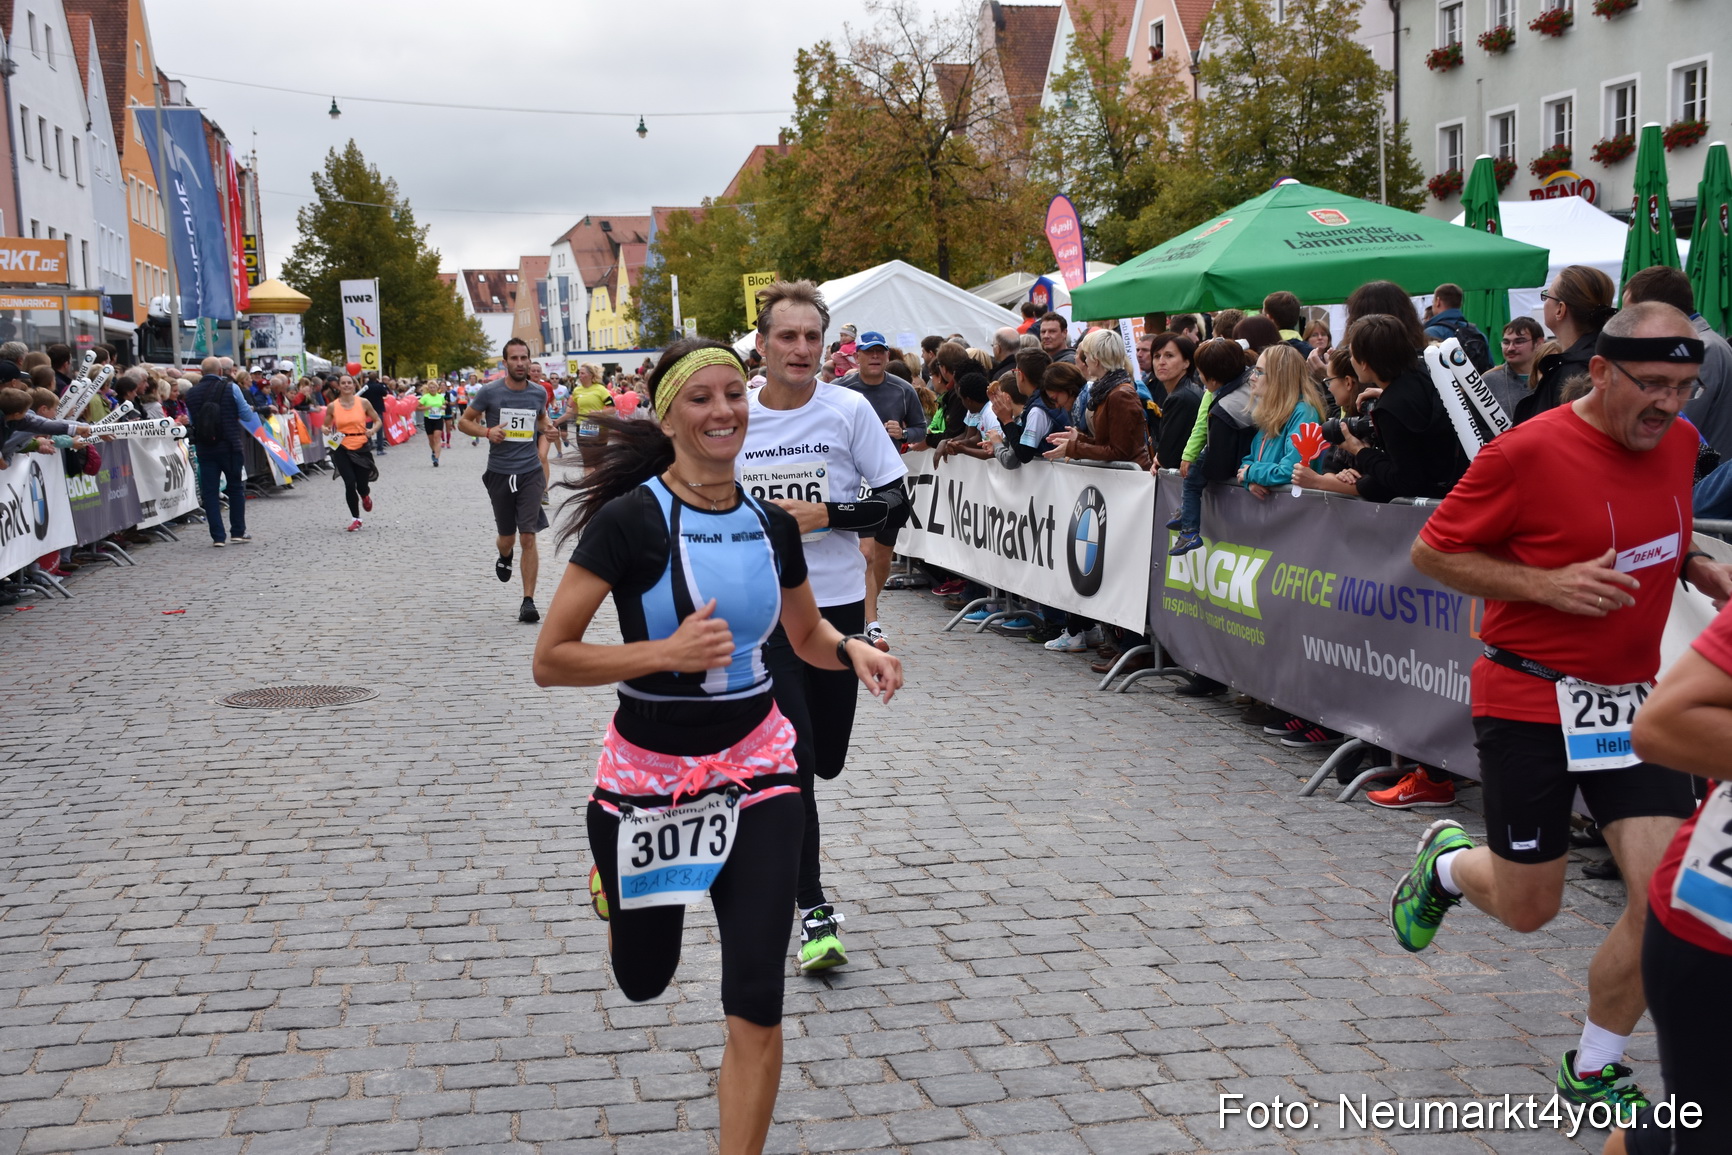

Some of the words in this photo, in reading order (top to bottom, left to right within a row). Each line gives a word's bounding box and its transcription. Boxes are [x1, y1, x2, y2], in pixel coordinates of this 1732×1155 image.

[1283, 232, 1424, 250] Lammsbräu
[1295, 226, 1393, 239] Neumarkter
[748, 275, 776, 286] Block
[364, 351, 374, 365] C
[429, 368, 436, 376] D
[1465, 370, 1496, 408] BMW
[90, 424, 131, 435] Laufsport
[132, 421, 155, 431] BMW
[511, 416, 525, 429] 51
[745, 443, 830, 460] www.hasit.de
[742, 472, 770, 483] PARTL
[771, 470, 813, 481] Neumarkt
[949, 479, 1056, 570] Neumarkt
[1632, 546, 1663, 564] DEHN
[1271, 562, 1337, 608] OFFICE
[1337, 575, 1462, 634] INDUSTRY
[1162, 592, 1199, 618] inspired
[1205, 611, 1226, 632] smart
[1226, 619, 1266, 646] concepts
[662, 800, 721, 820] Neumarkt
[631, 813, 727, 869] 3073
